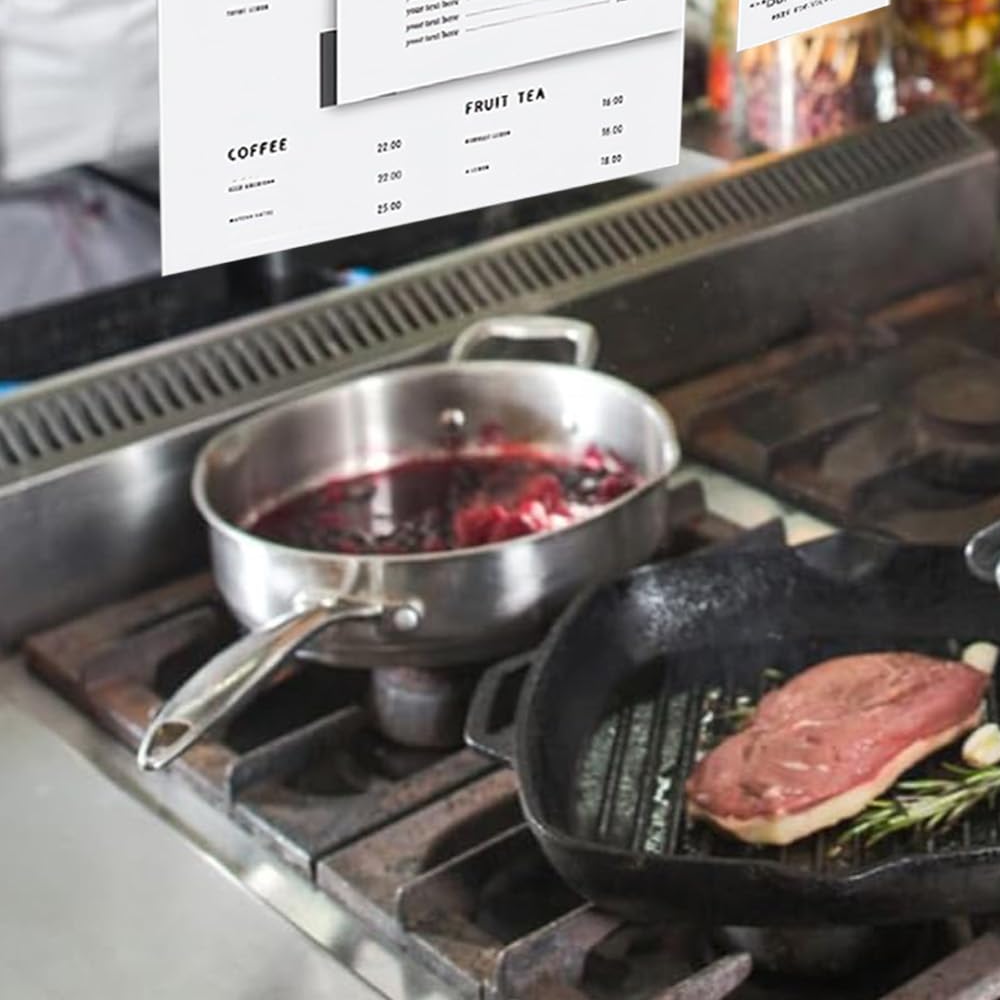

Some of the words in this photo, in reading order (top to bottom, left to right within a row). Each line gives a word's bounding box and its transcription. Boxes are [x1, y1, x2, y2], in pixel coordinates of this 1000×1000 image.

[465, 95, 508, 115] FRUIT
[518, 88, 545, 104] TEA
[228, 138, 287, 161] COFFEE
